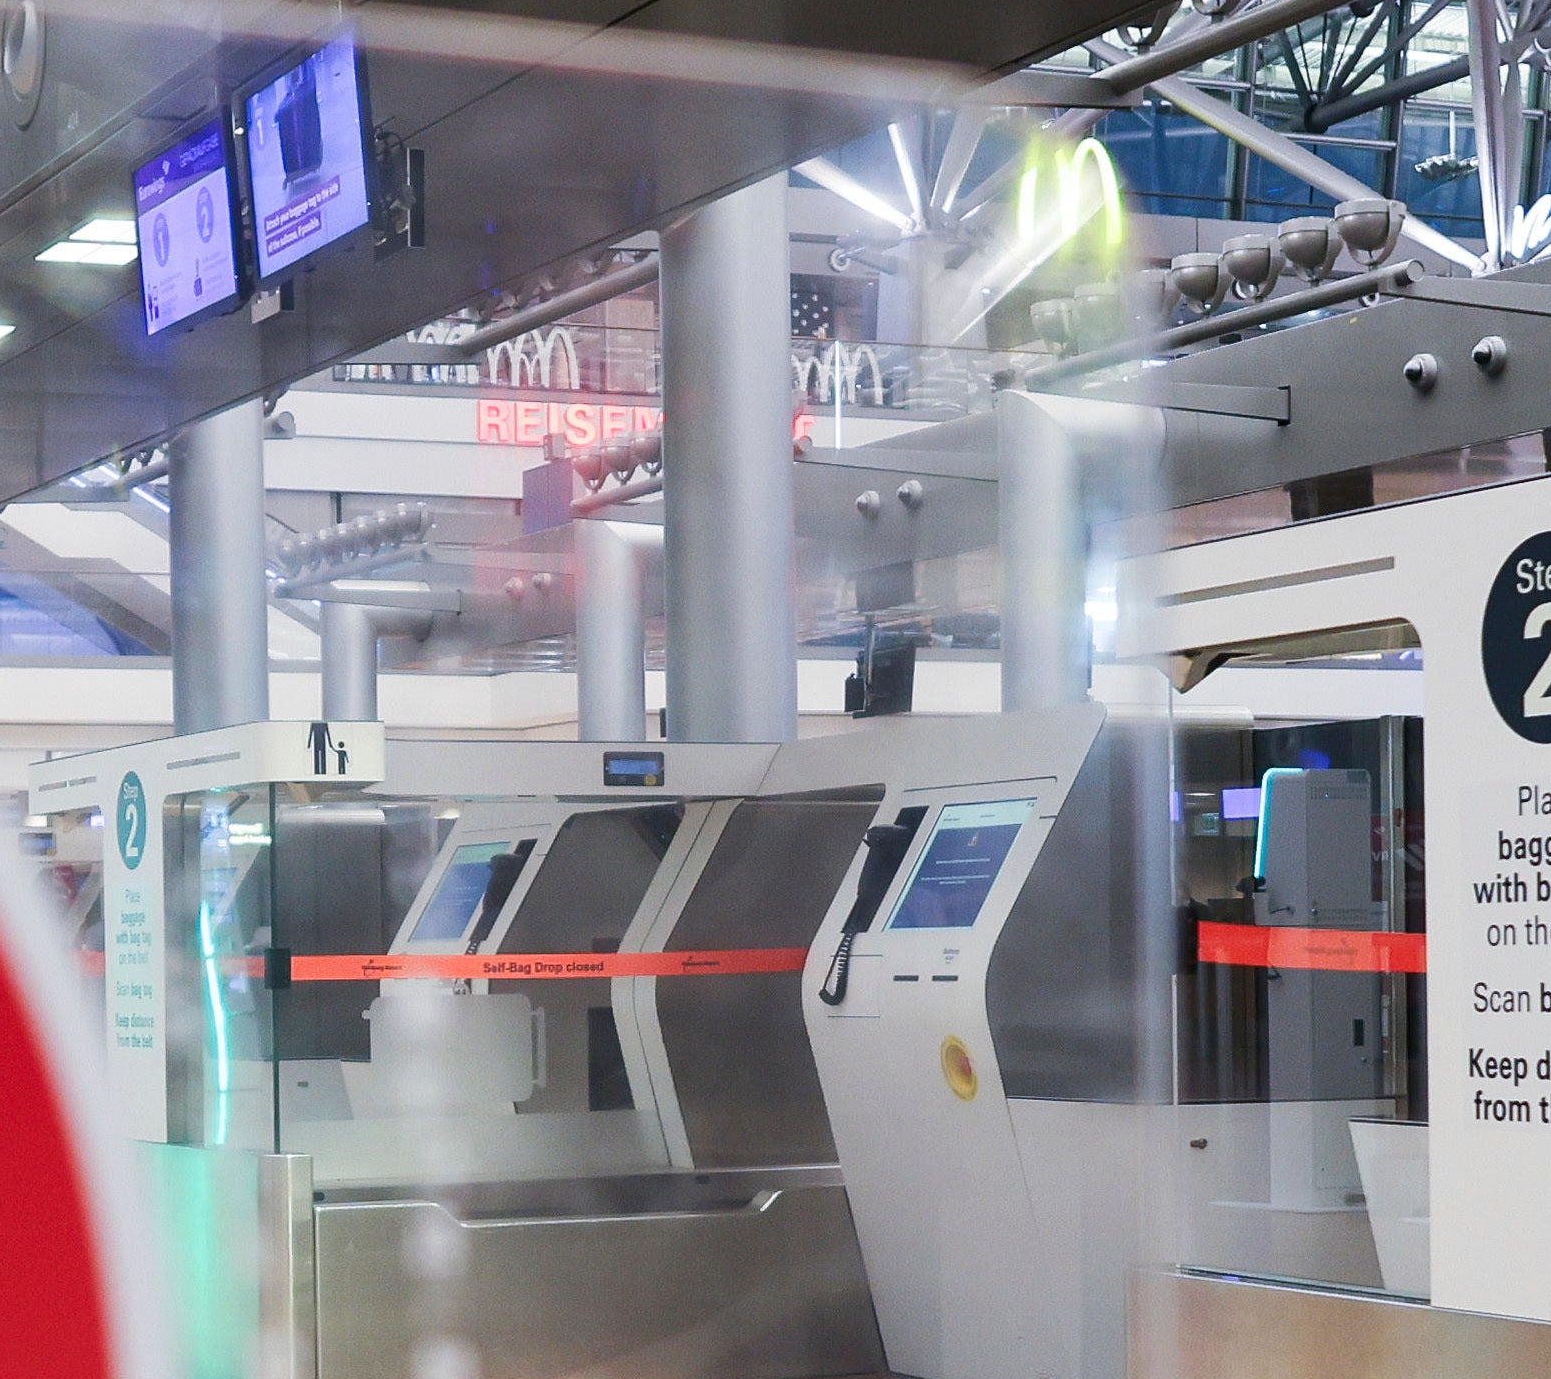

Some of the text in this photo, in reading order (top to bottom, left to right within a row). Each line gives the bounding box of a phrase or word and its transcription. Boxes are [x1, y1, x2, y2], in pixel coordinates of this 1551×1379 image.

[123, 781, 139, 802] Step
[125, 803, 139, 857] 2
[1473, 872, 1527, 904] with
[1487, 923, 1516, 947] on
[483, 960, 605, 975] Self-Bag Drop closed
[1473, 982, 1531, 1013] Scan
[1468, 1048, 1528, 1086] Keep
[1474, 1090, 1530, 1123] from
